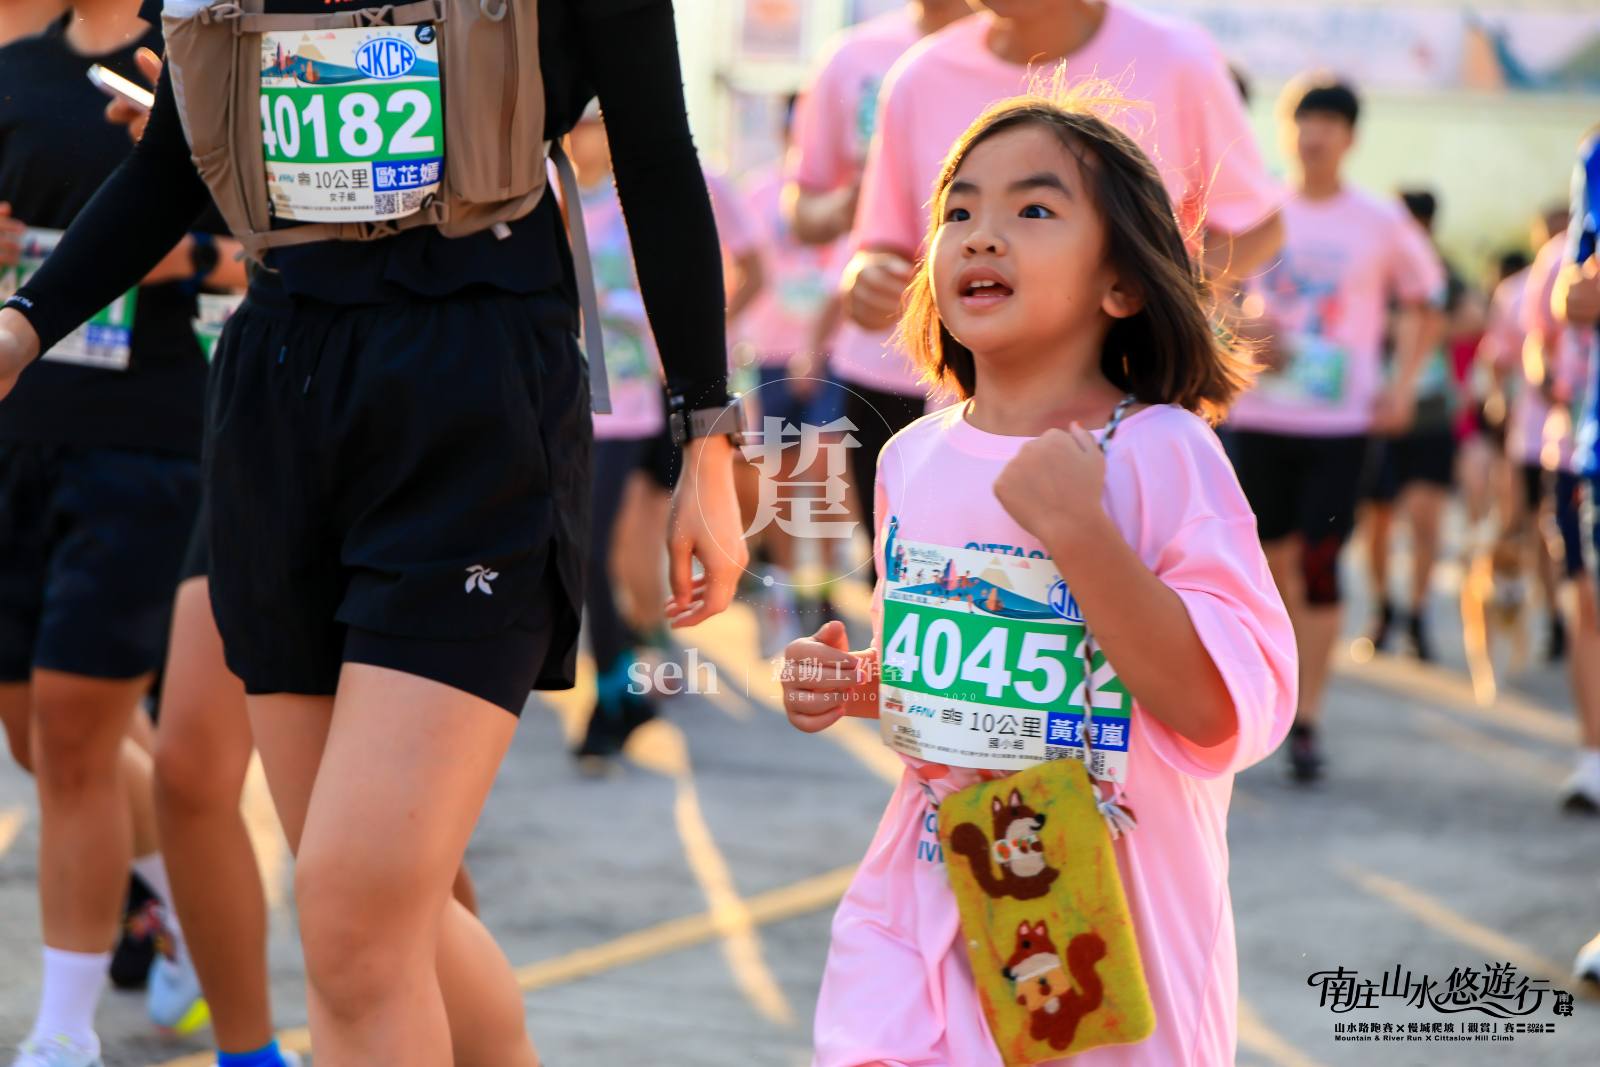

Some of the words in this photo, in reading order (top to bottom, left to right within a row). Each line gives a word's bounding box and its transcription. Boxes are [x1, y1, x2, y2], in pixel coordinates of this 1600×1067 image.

[361, 41, 414, 77] JKCR
[260, 89, 435, 158] 40182
[315, 168, 369, 189] 10公里
[884, 612, 1123, 710] 40452
[969, 712, 1042, 738] 10公里
